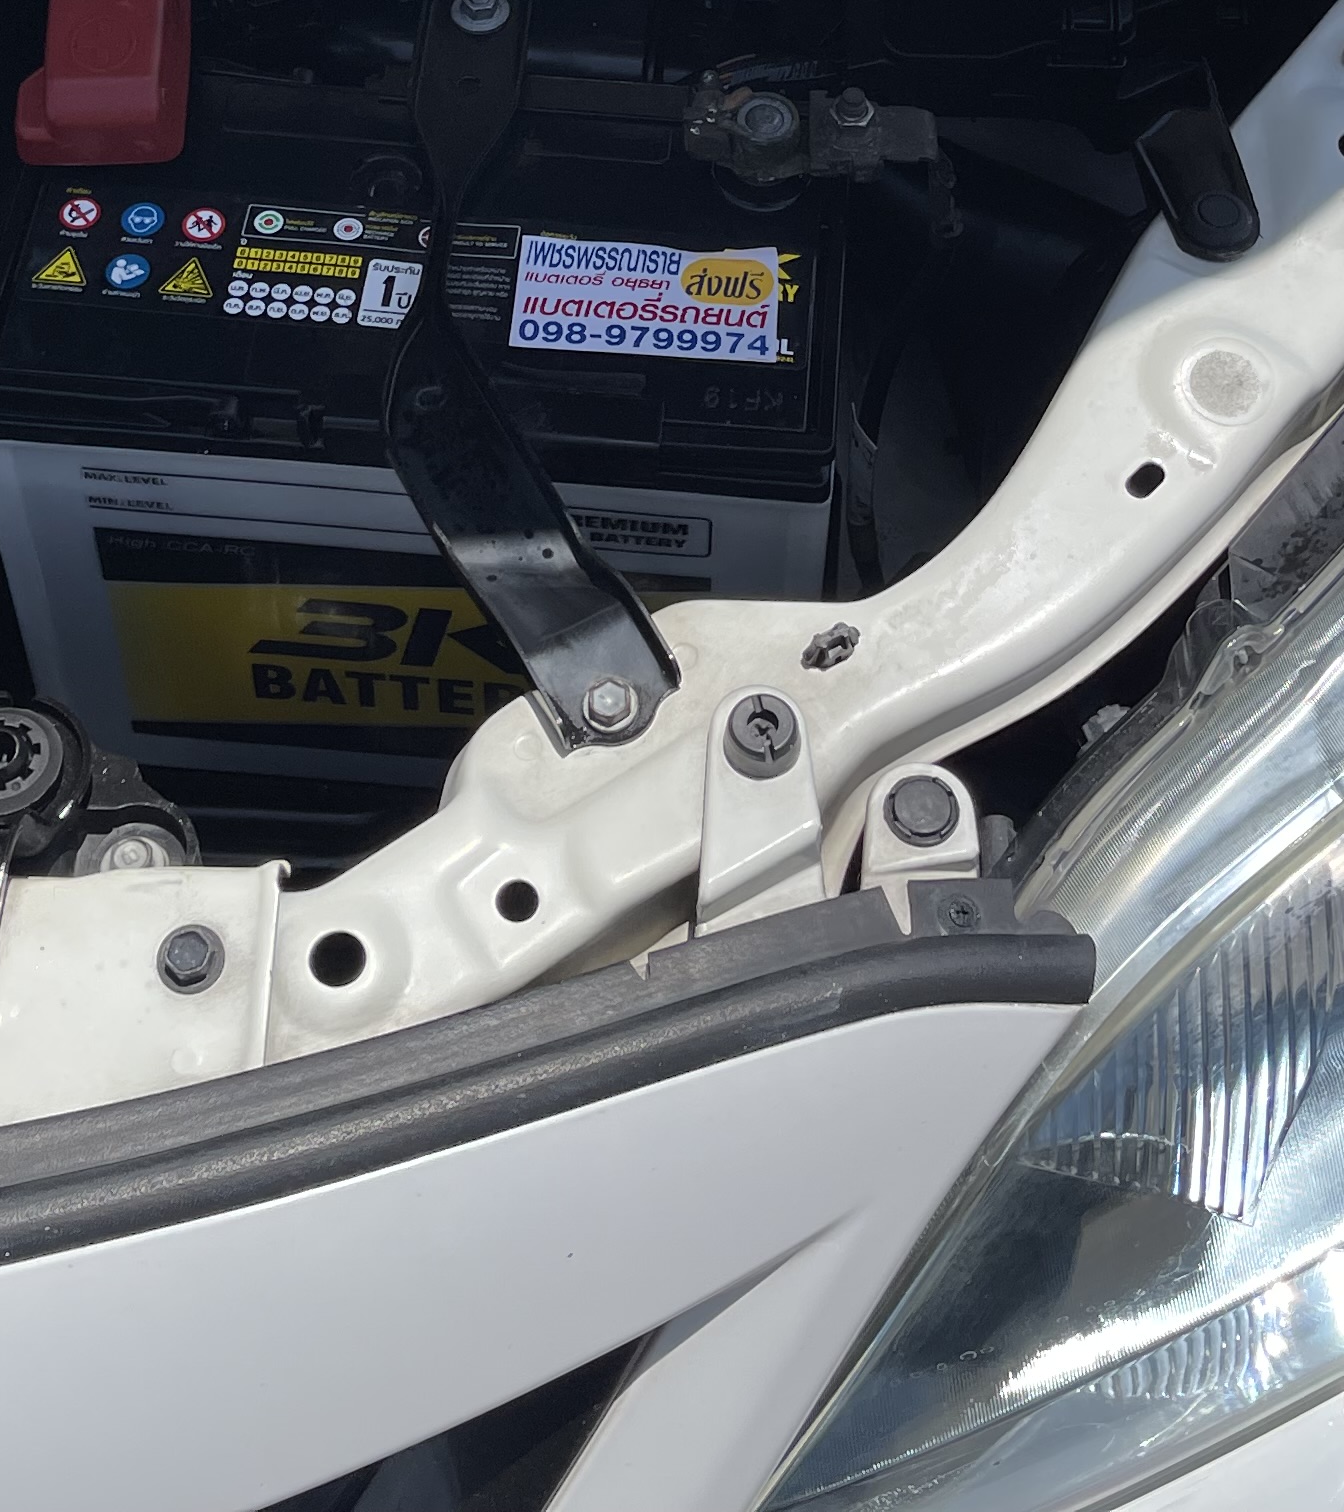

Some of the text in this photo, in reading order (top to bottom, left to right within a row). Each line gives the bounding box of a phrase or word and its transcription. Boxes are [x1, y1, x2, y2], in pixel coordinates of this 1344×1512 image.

[381, 276, 396, 307] 1
[612, 276, 671, 291] อยุธยา
[685, 268, 765, 300] ส่งฟรี
[523, 293, 769, 329] แบตเตอรี่รถยนต์
[519, 319, 769, 356] 098-9799974
[570, 514, 689, 536] REMIUM
[590, 531, 687, 548] BATTERY
